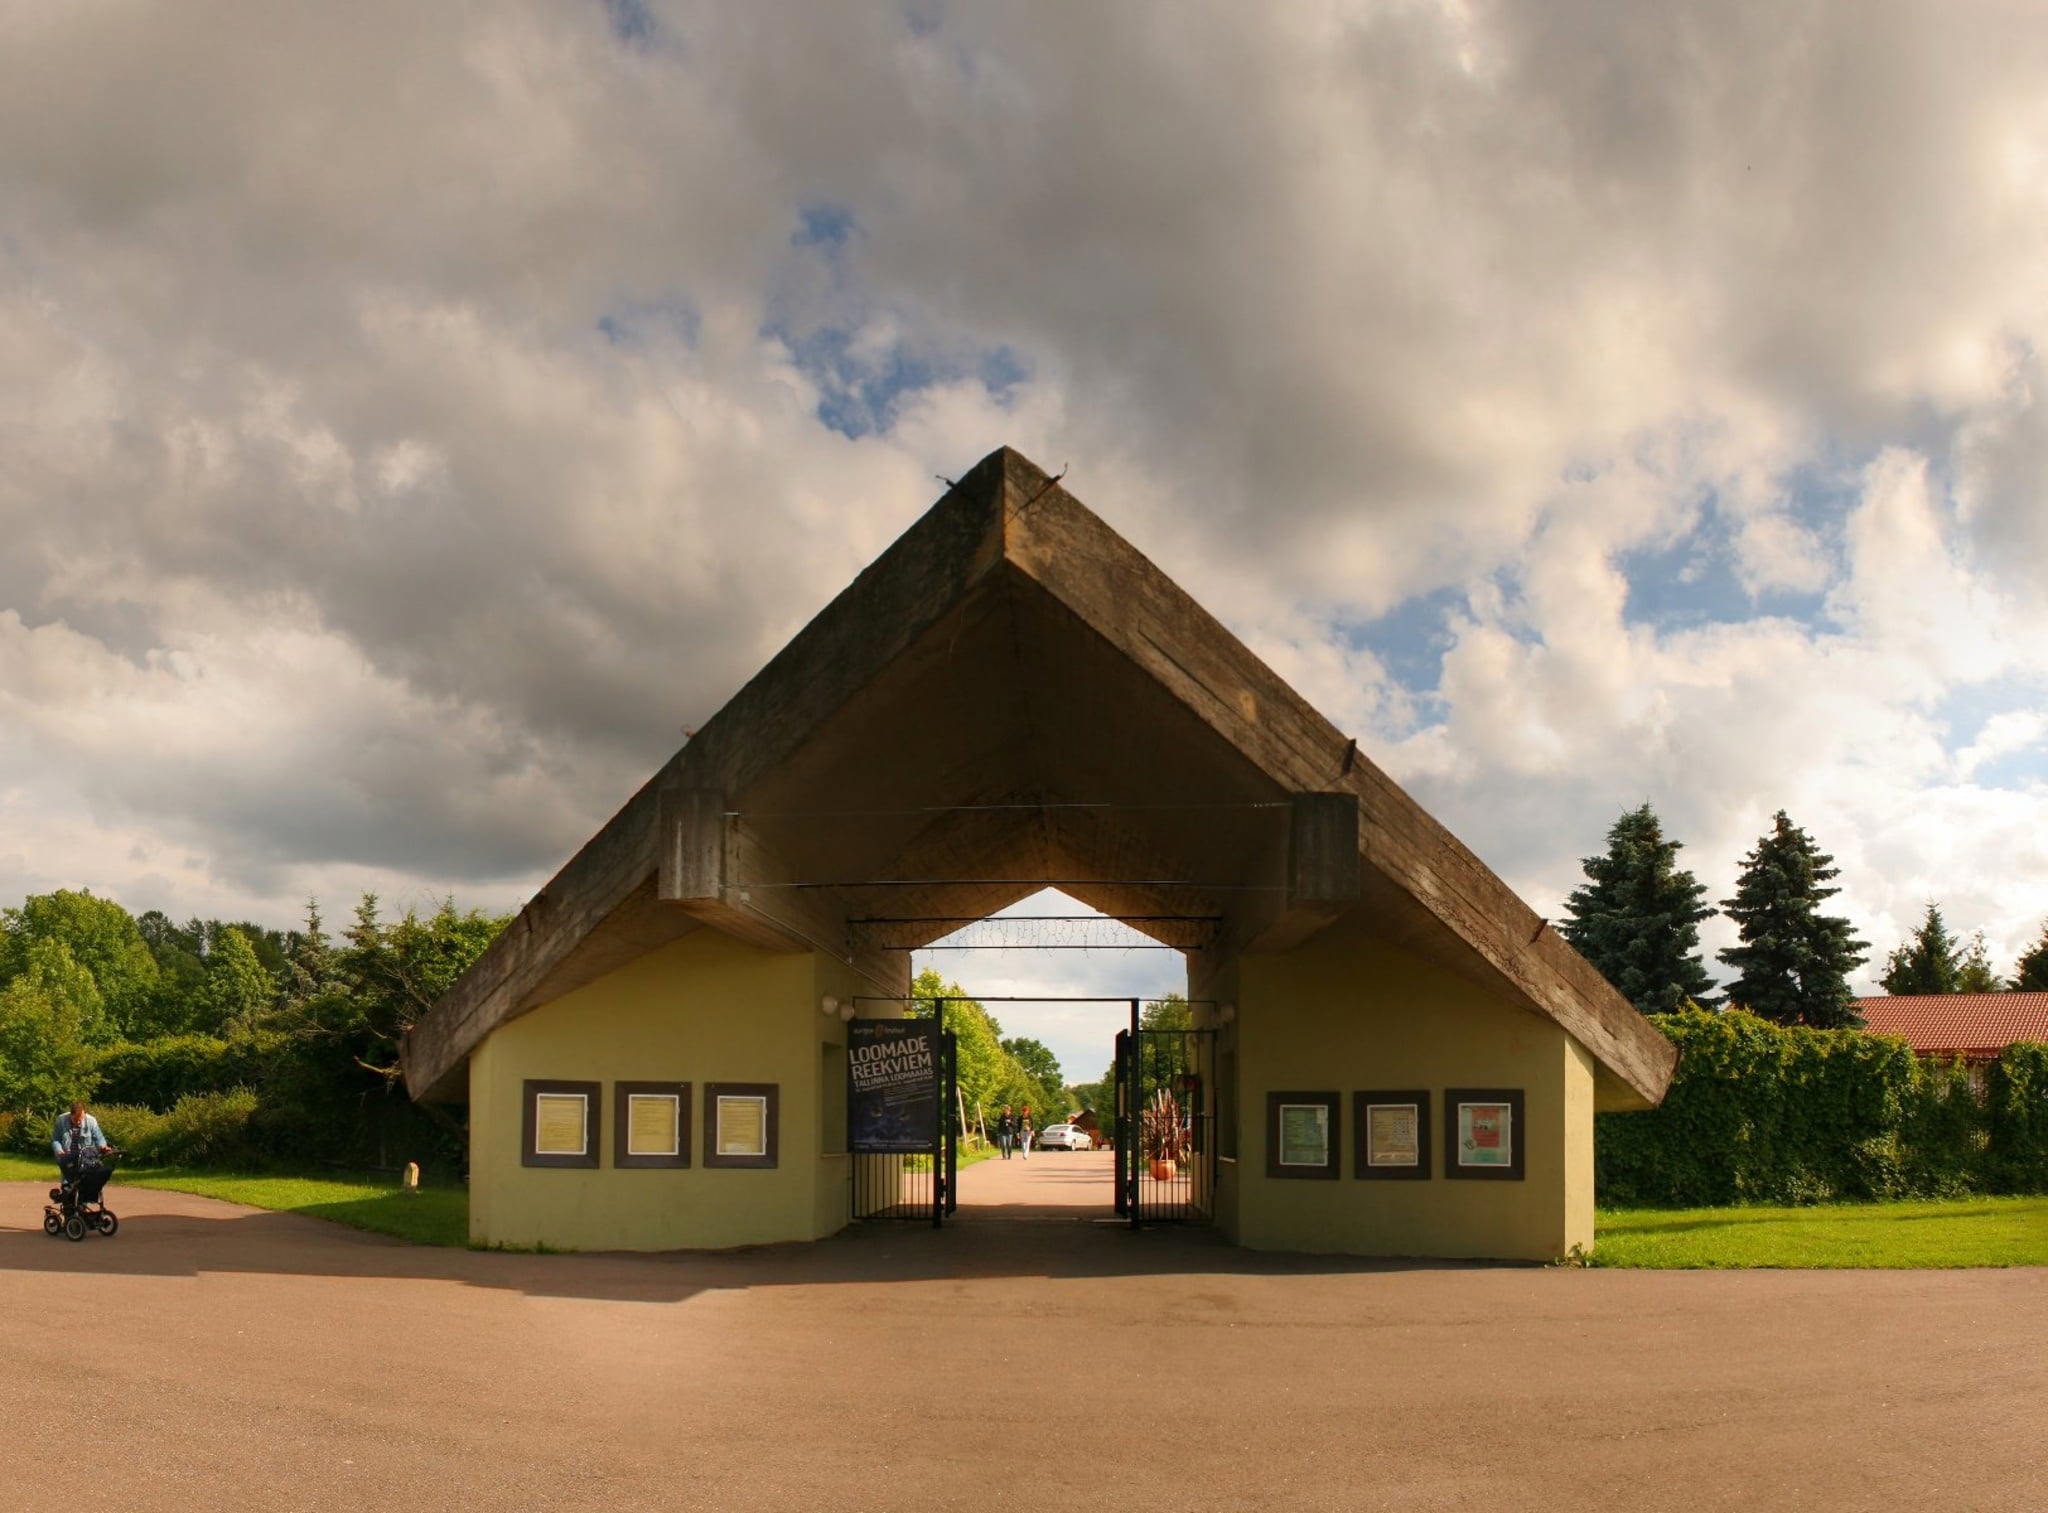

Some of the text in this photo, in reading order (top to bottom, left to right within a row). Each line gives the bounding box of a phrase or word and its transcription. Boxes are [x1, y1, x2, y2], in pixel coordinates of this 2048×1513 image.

[849, 1036, 930, 1065] LOOMADE
[852, 1052, 932, 1080] REEKVIEM
[854, 1075, 889, 1088] TALLINNA
